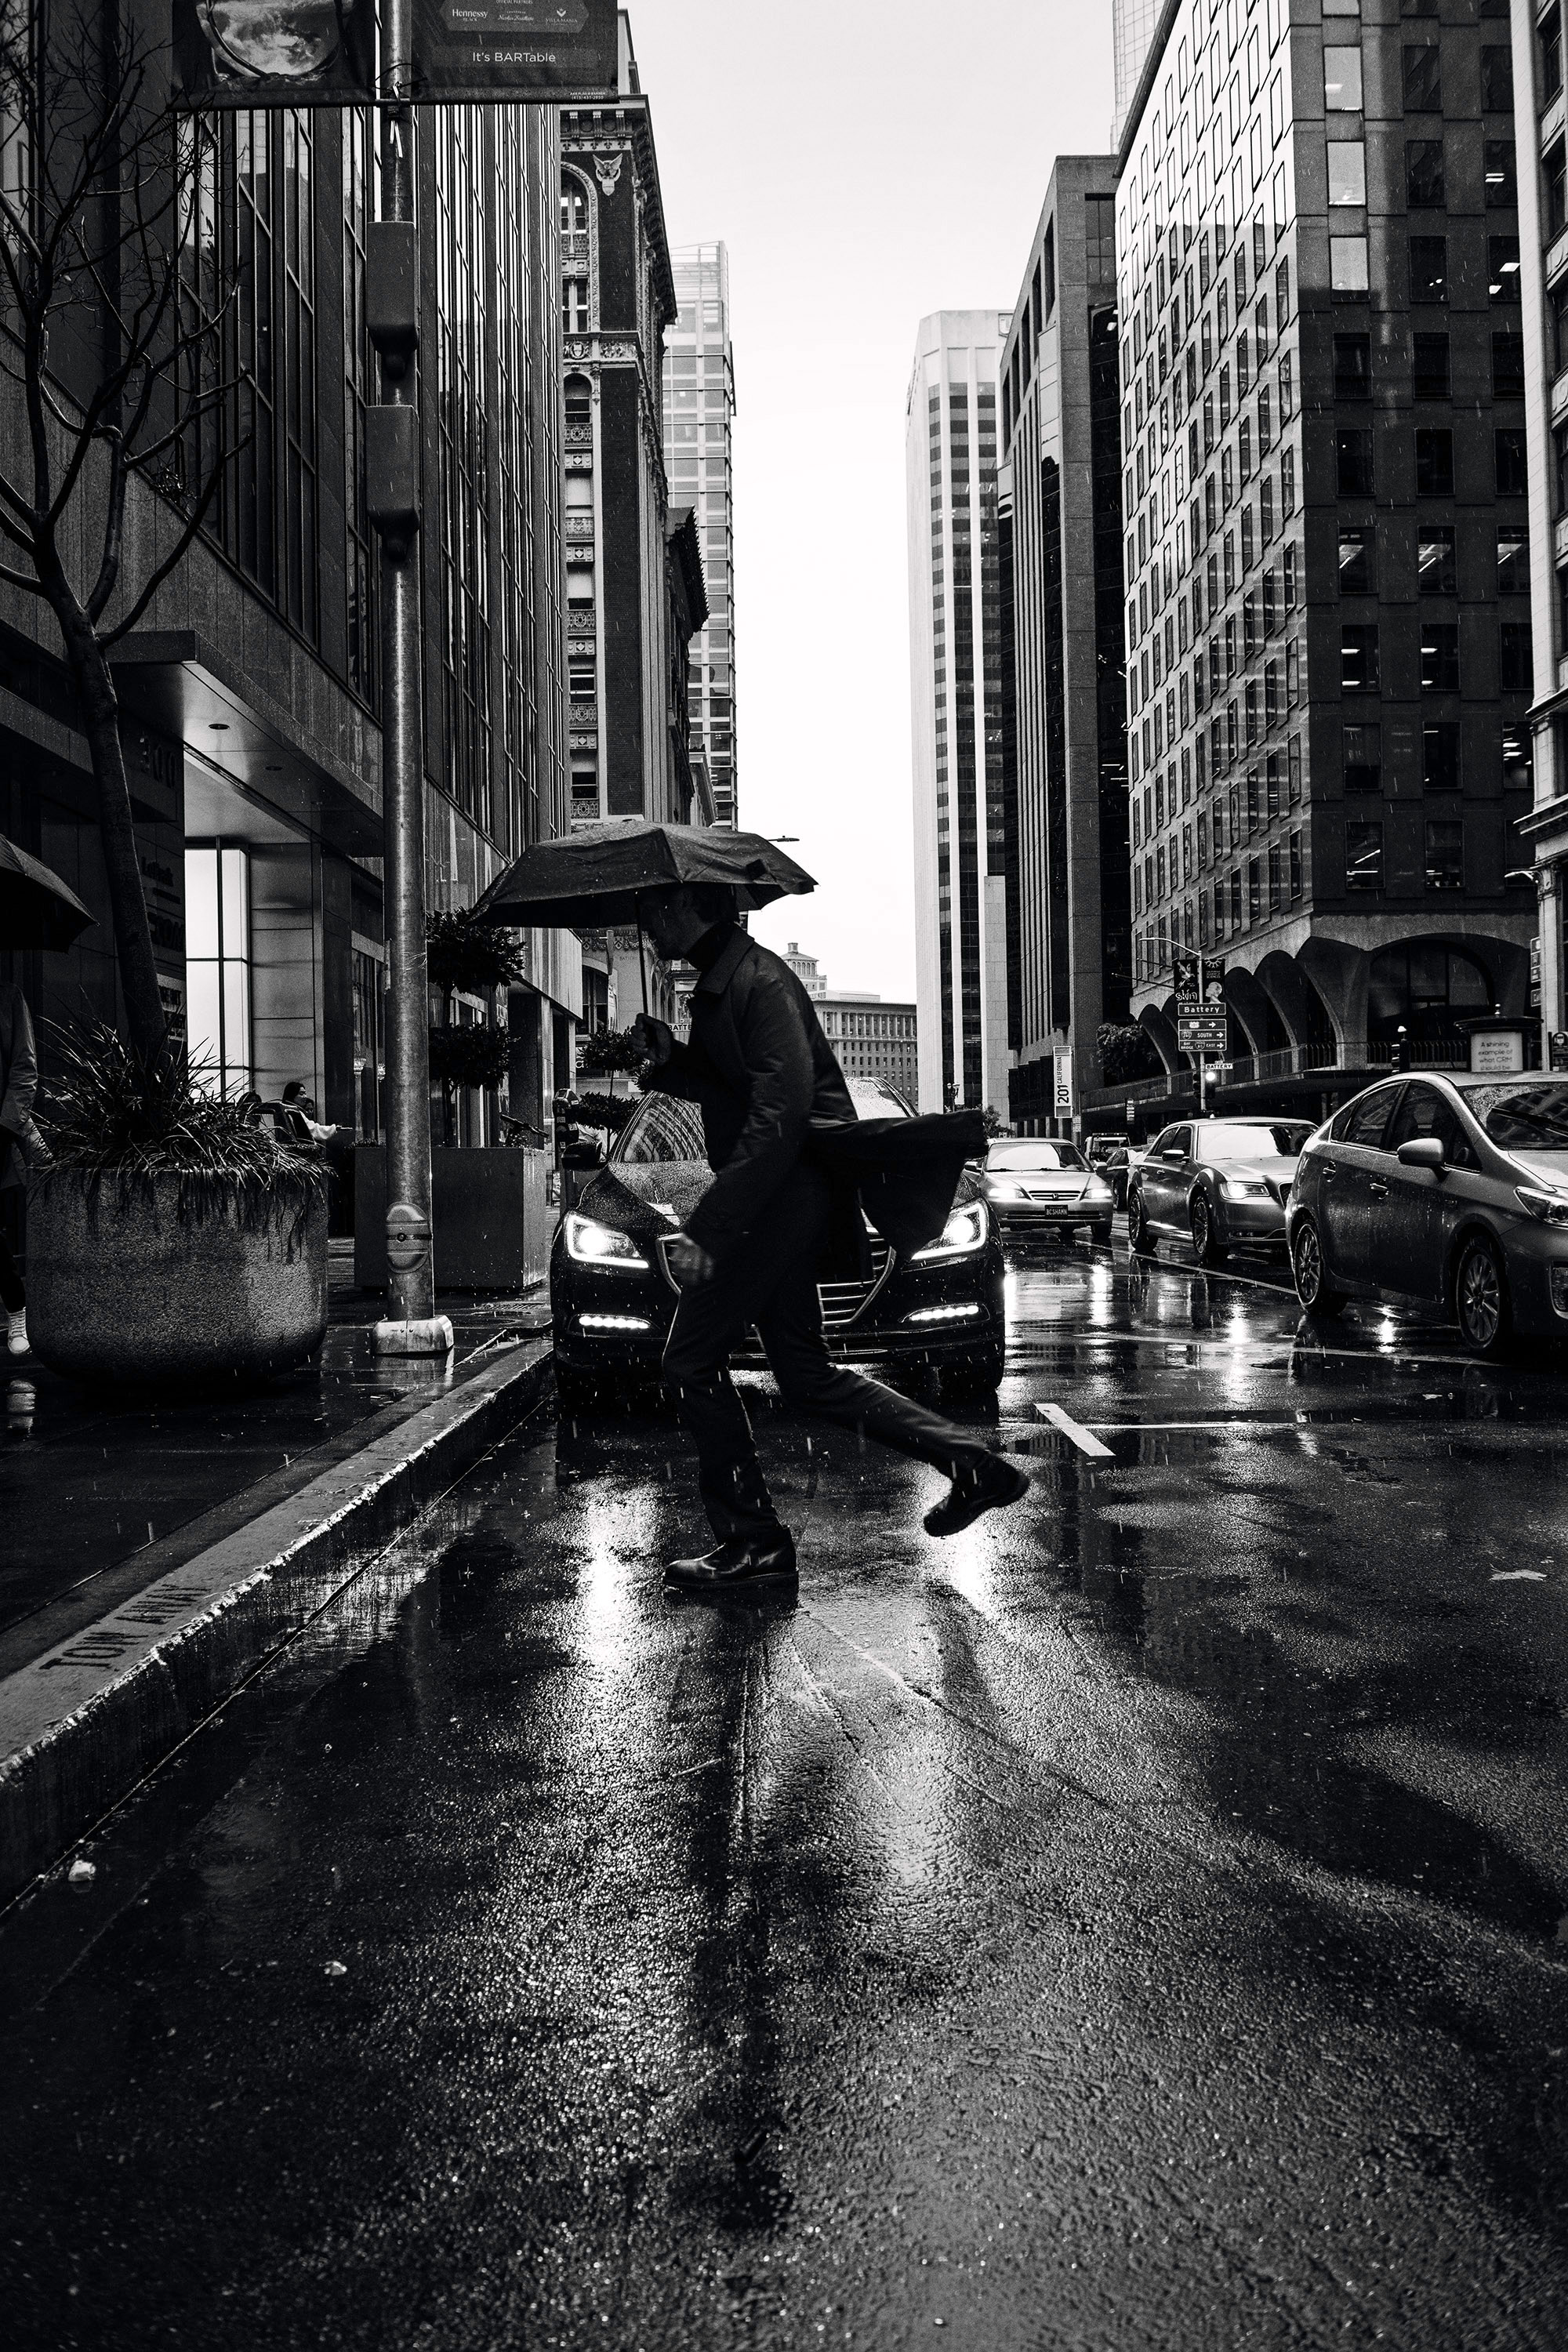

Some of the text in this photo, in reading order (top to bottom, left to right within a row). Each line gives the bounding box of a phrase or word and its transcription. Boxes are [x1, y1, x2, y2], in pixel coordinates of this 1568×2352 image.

[452, 9, 488, 18] Hennessy
[473, 53, 556, 62] It's BARTable
[1057, 1085, 1069, 1103] 201
